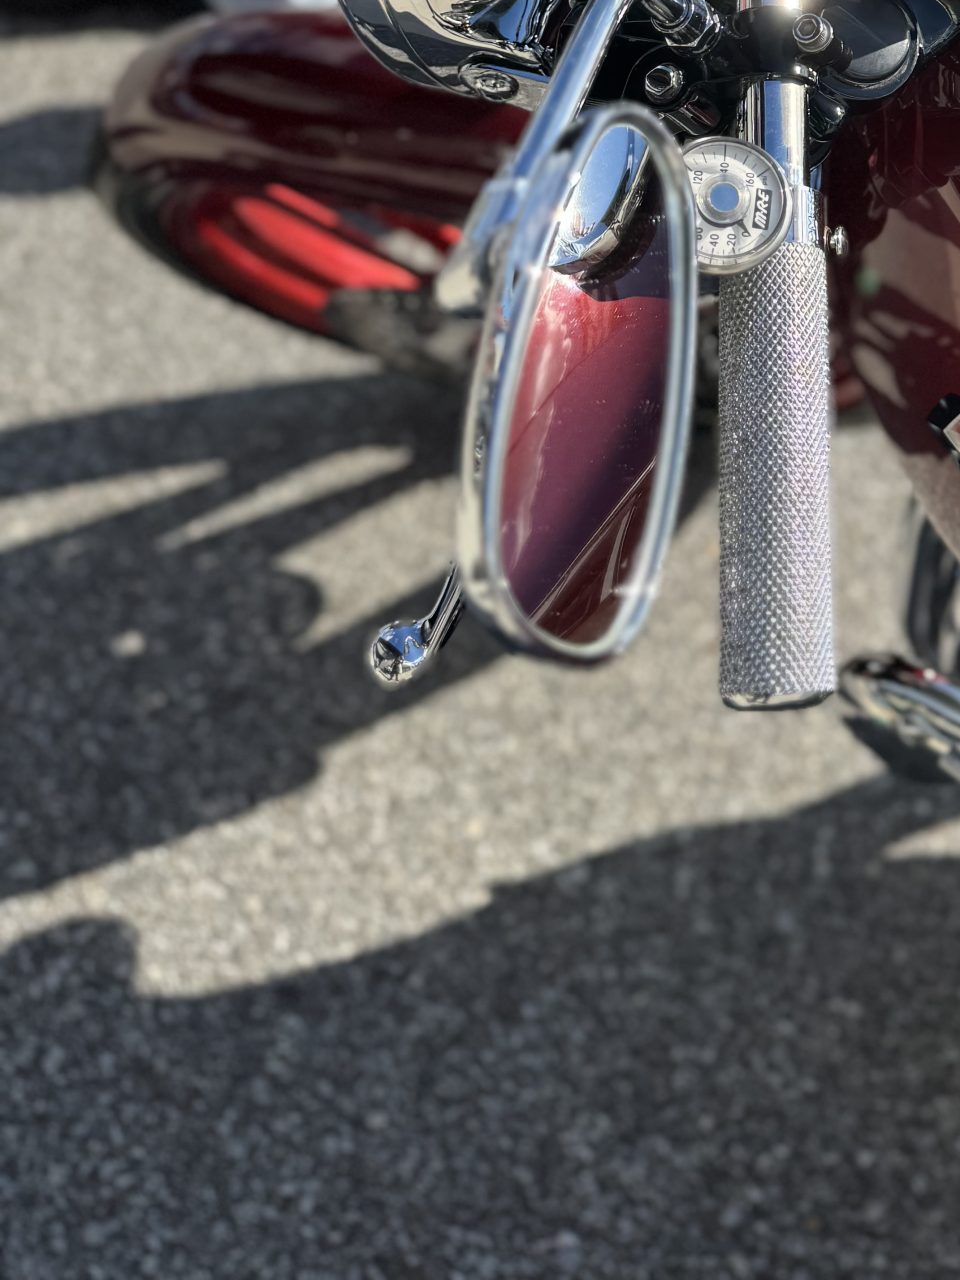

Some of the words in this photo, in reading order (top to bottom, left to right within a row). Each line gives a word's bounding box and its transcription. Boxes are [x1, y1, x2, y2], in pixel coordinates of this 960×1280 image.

[720, 162, 730, 174] 40
[693, 170, 704, 184] 120
[746, 172, 755, 187] 160
[710, 234, 720, 247] 40
[726, 233, 737, 247] 20
